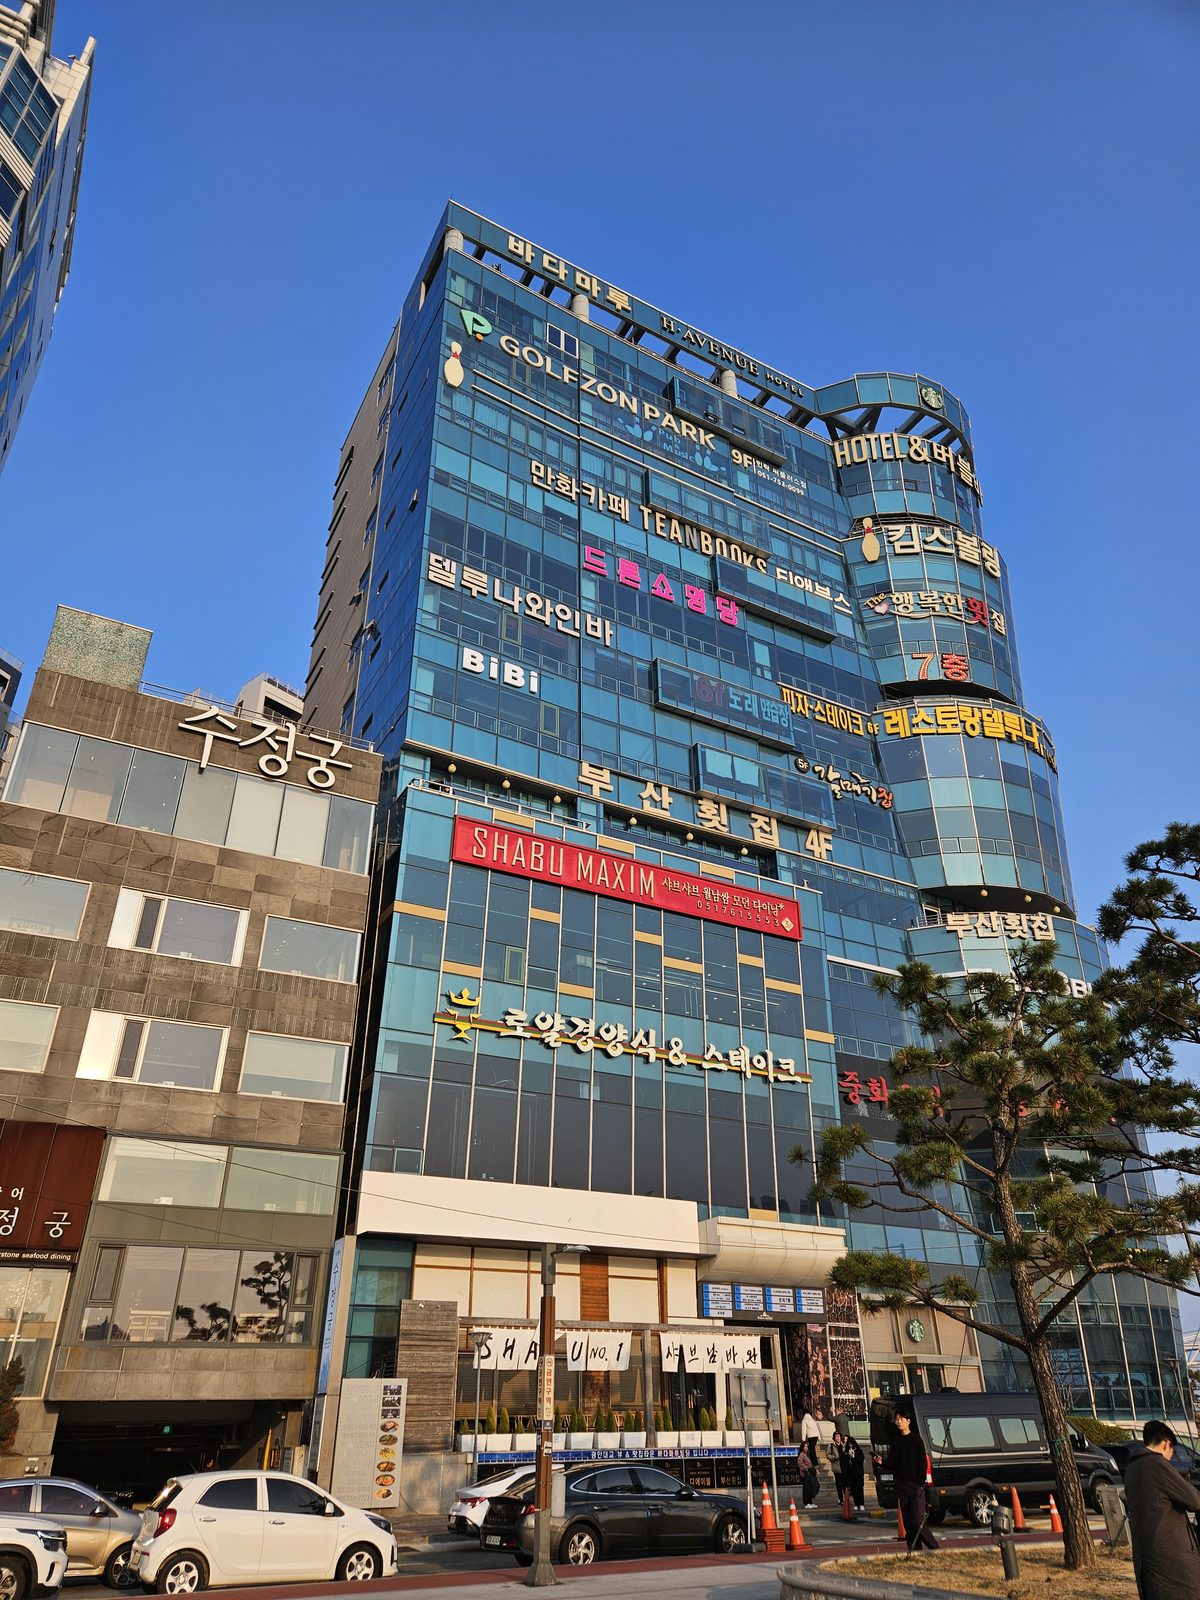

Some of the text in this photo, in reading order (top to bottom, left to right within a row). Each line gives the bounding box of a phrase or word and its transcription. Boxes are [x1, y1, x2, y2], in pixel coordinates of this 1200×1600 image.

[507, 235, 633, 313] 바다마루
[499, 335, 716, 451] GOLFZON PARK
[766, 372, 804, 398] HOTEL
[731, 448, 754, 470] 9F
[530, 459, 631, 523] 만화카페
[639, 504, 769, 575] TEANBOOKS
[888, 523, 1001, 579] 킴스볼링
[427, 551, 615, 648] 델루나와인바
[583, 544, 740, 627] 드론쇼명당
[864, 592, 887, 609] The
[461, 645, 541, 695] BiBi
[911, 652, 969, 682] 7층
[760, 697, 791, 729] 연습장
[866, 721, 880, 735] 6F
[883, 703, 1039, 750] 레스토랑델루나
[178, 704, 354, 789] 수정궁
[797, 757, 809, 770] 5F
[578, 761, 834, 862] 부산횟집 4F
[471, 826, 656, 900] SHABU MAXIM
[661, 876, 700, 898] 샤브샤브
[702, 886, 730, 905] 월남쌈
[732, 894, 750, 911] 모던
[945, 911, 1056, 941] 부산횟집
[499, 1007, 802, 1083] 로얄경양식 & 스테이크
[21, 1252, 49, 1260] seafood
[50, 1254, 72, 1262] dining
[481, 1335, 585, 1364] SHAU
